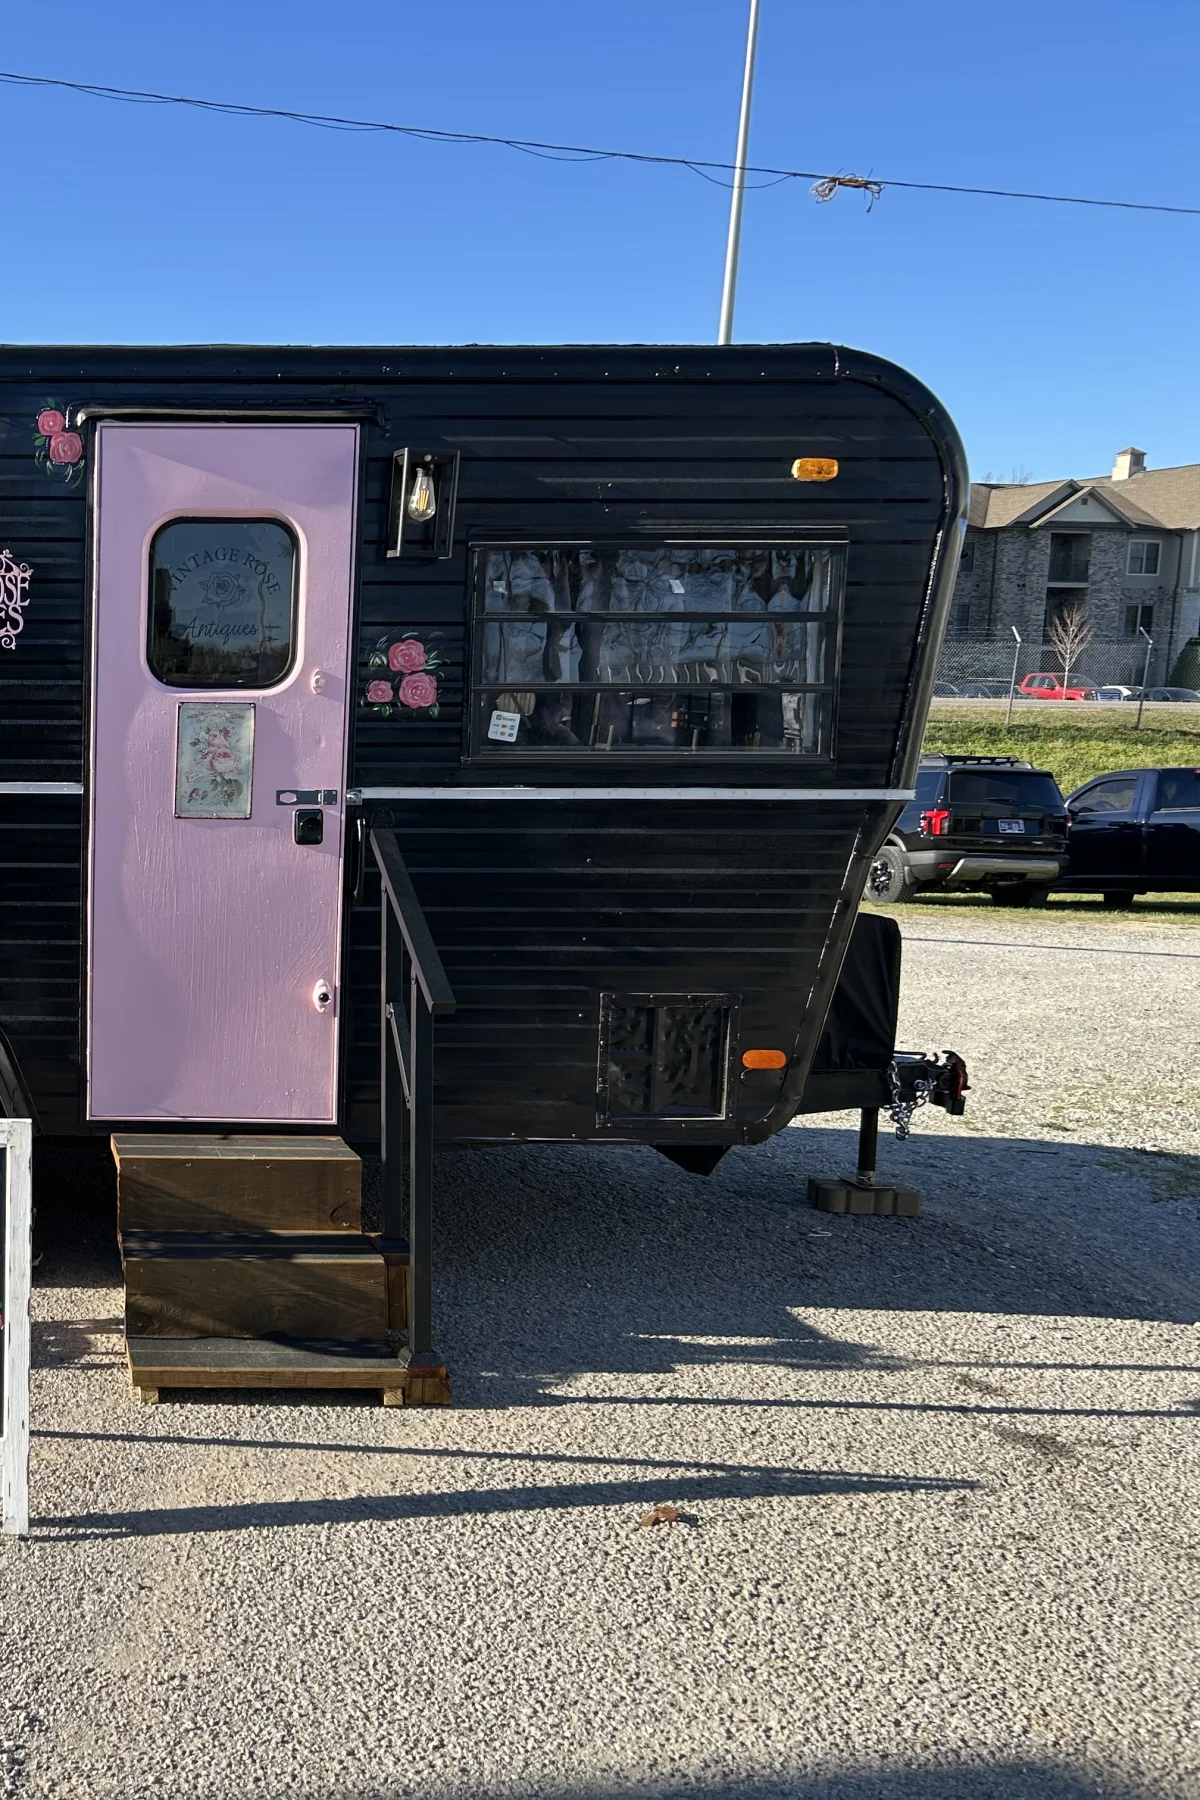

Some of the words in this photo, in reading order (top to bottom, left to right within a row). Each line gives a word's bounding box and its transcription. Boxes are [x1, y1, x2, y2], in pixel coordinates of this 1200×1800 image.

[167, 547, 240, 592] VINTAGE
[243, 553, 282, 595] ROSE
[183, 616, 259, 646] Antiques
